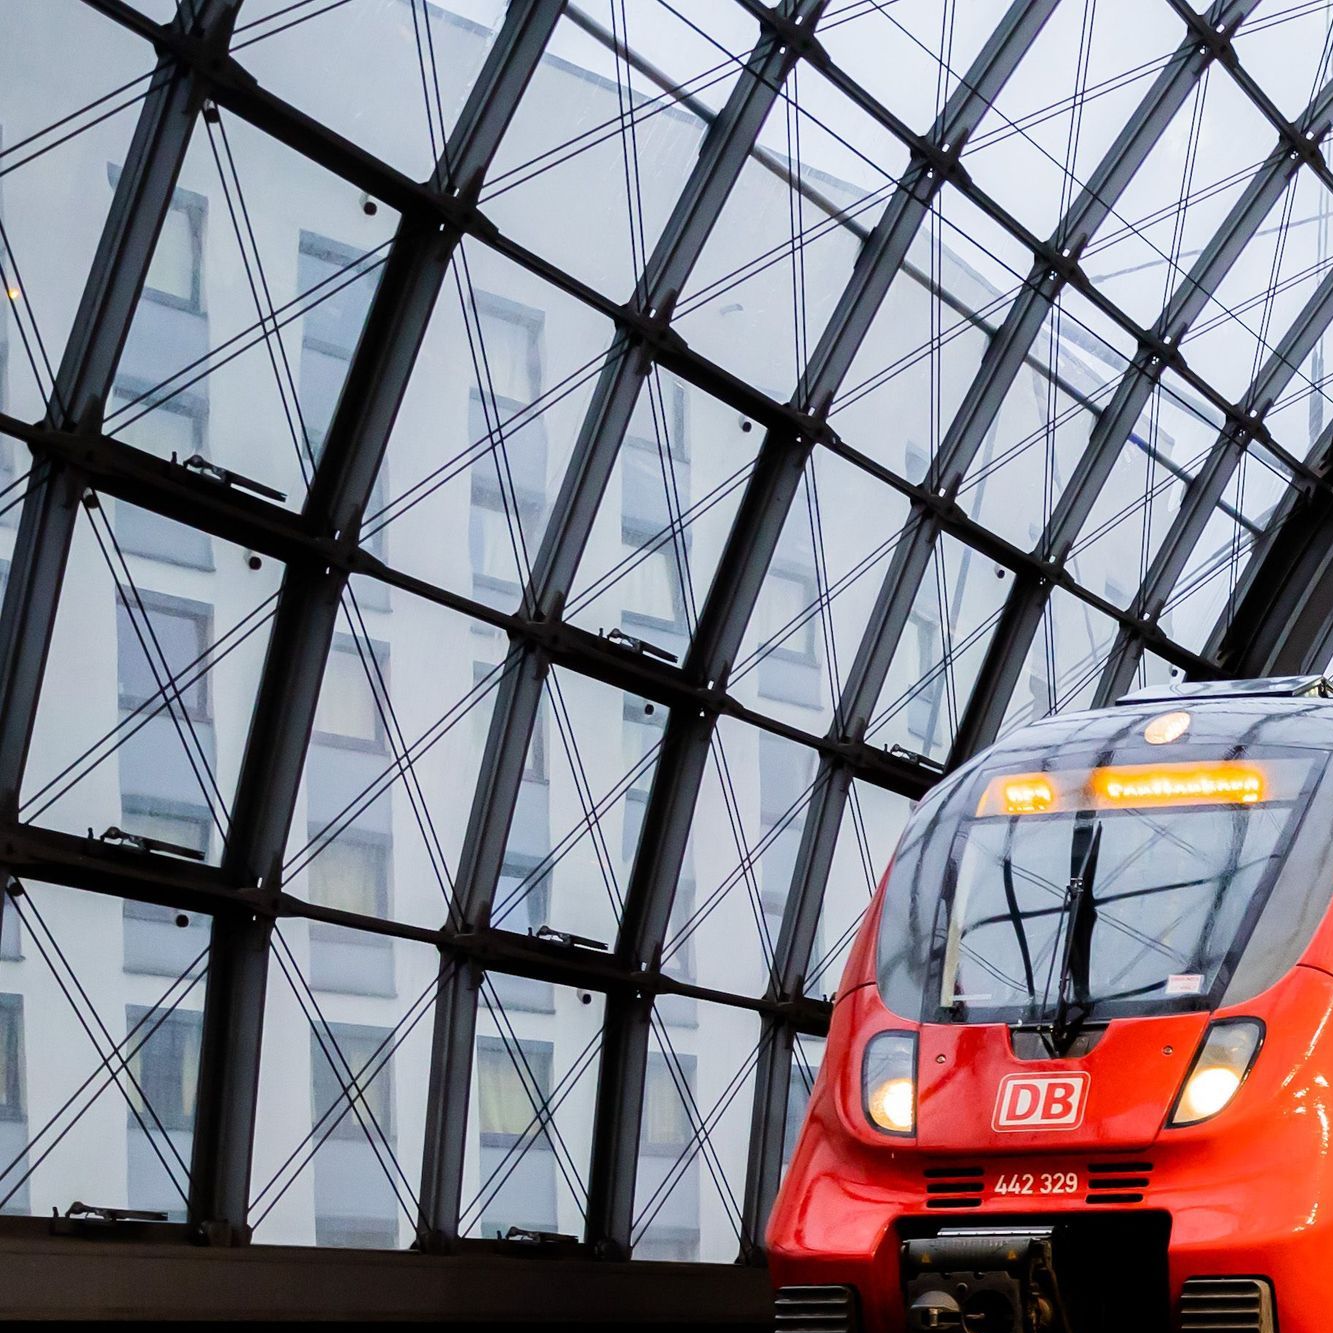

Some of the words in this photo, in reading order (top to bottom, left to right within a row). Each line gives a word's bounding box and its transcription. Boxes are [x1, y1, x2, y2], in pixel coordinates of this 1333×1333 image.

[1004, 1080, 1077, 1122] DB
[994, 1173, 1034, 1195] 442
[1040, 1172, 1078, 1194] 329
